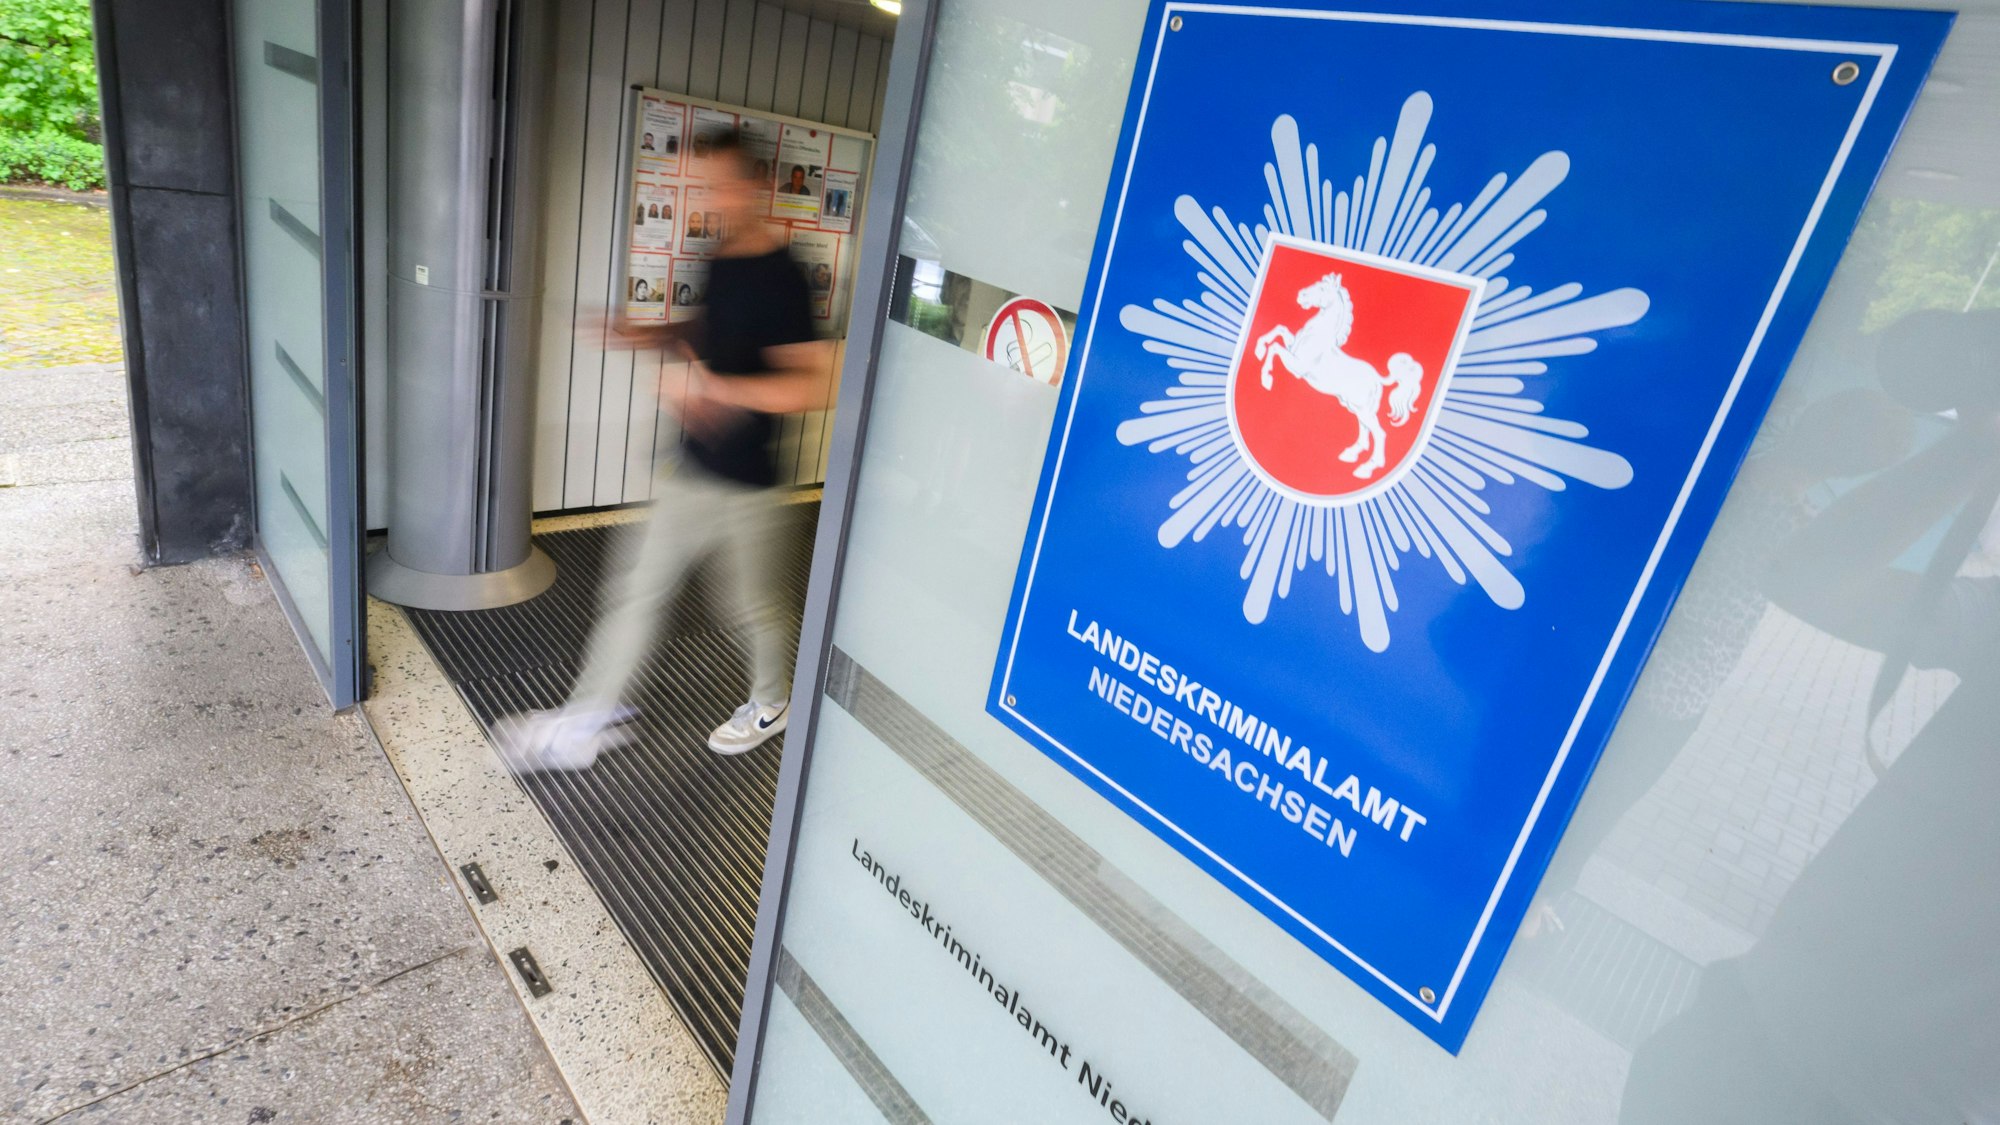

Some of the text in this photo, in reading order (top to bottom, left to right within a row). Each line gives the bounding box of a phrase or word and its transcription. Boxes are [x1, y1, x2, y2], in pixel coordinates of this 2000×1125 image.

[1066, 608, 1428, 842] LANDESKRIMINALAMT
[1088, 666, 1358, 858] NIEDERSACHSEN
[851, 838, 1072, 1070] Landeskriminalamt
